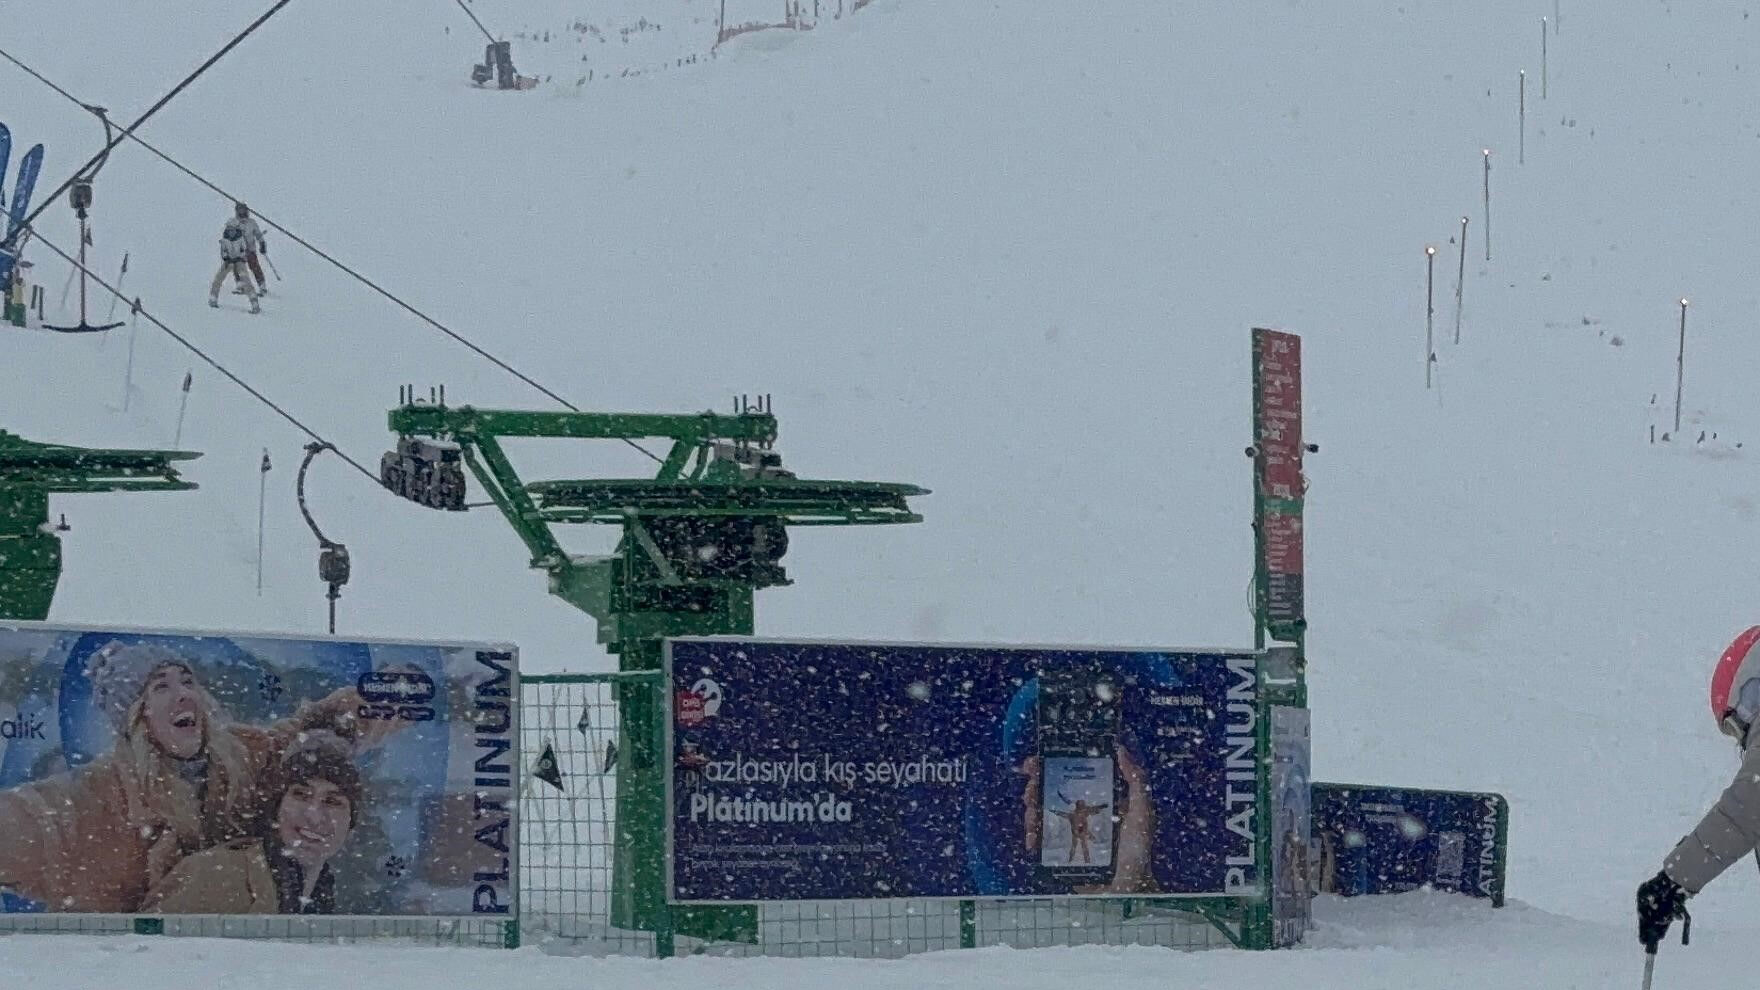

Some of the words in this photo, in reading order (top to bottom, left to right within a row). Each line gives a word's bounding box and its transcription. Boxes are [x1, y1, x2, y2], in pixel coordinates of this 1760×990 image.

[473, 651, 511, 913] PLATINUM
[690, 792, 852, 823] Platinum'da
[692, 751, 817, 789] azlasıyla
[825, 753, 857, 790] kış
[865, 754, 967, 789] seyahati
[1225, 658, 1256, 895] PLATINUM
[1477, 797, 1499, 897] ATINUM
